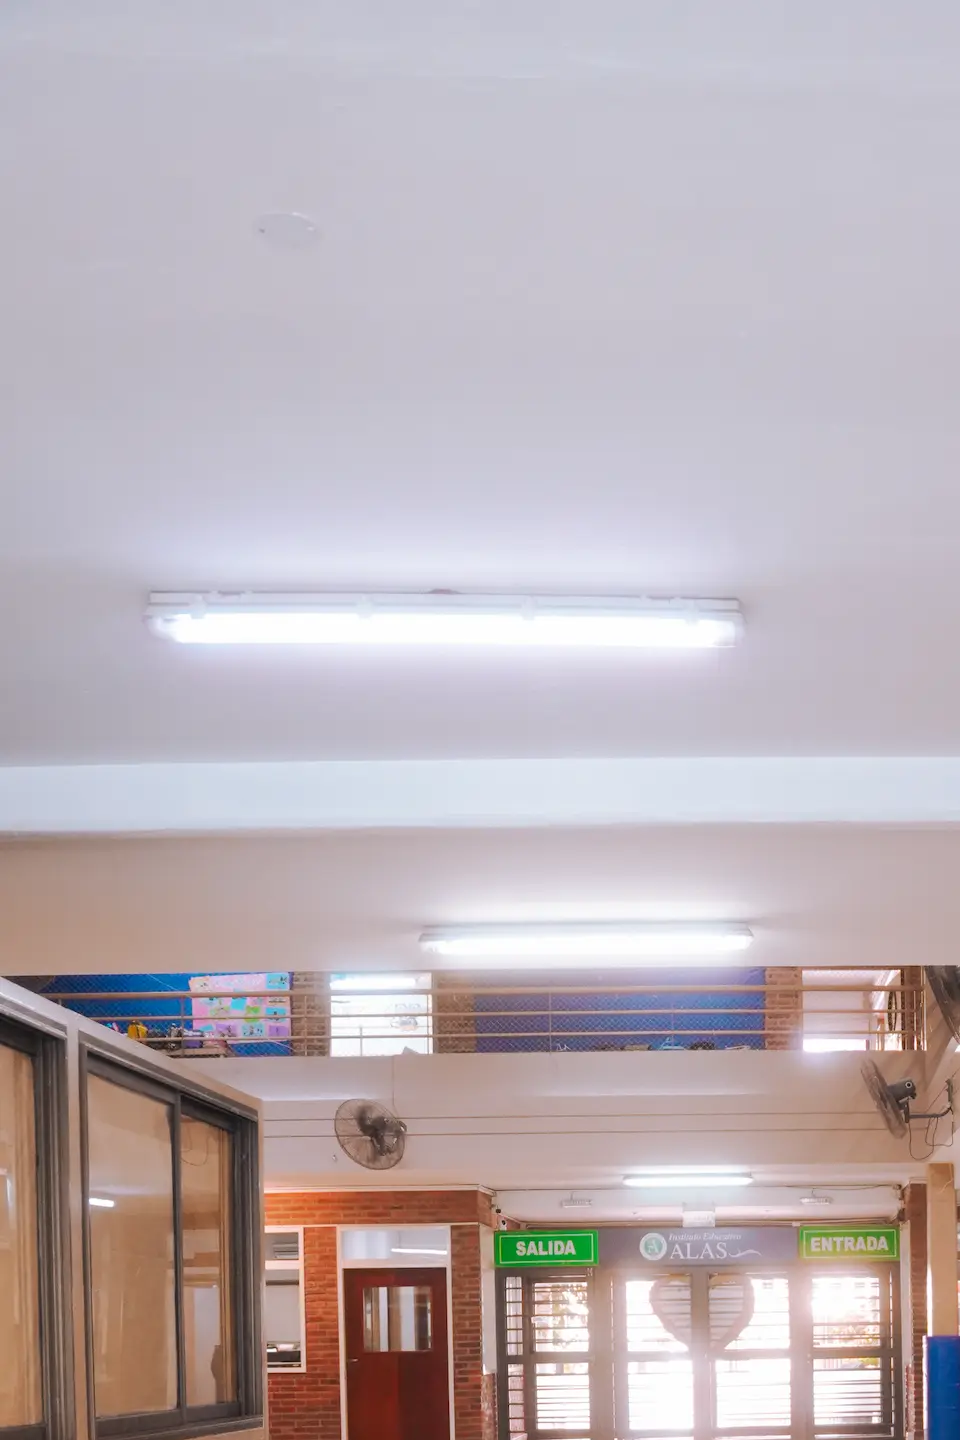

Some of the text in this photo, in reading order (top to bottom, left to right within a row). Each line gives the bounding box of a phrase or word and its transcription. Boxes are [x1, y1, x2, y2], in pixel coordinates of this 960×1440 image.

[515, 1240, 576, 1256] SALIDA
[670, 1242, 728, 1260] ALAS
[811, 1235, 888, 1252] ENTRADA
